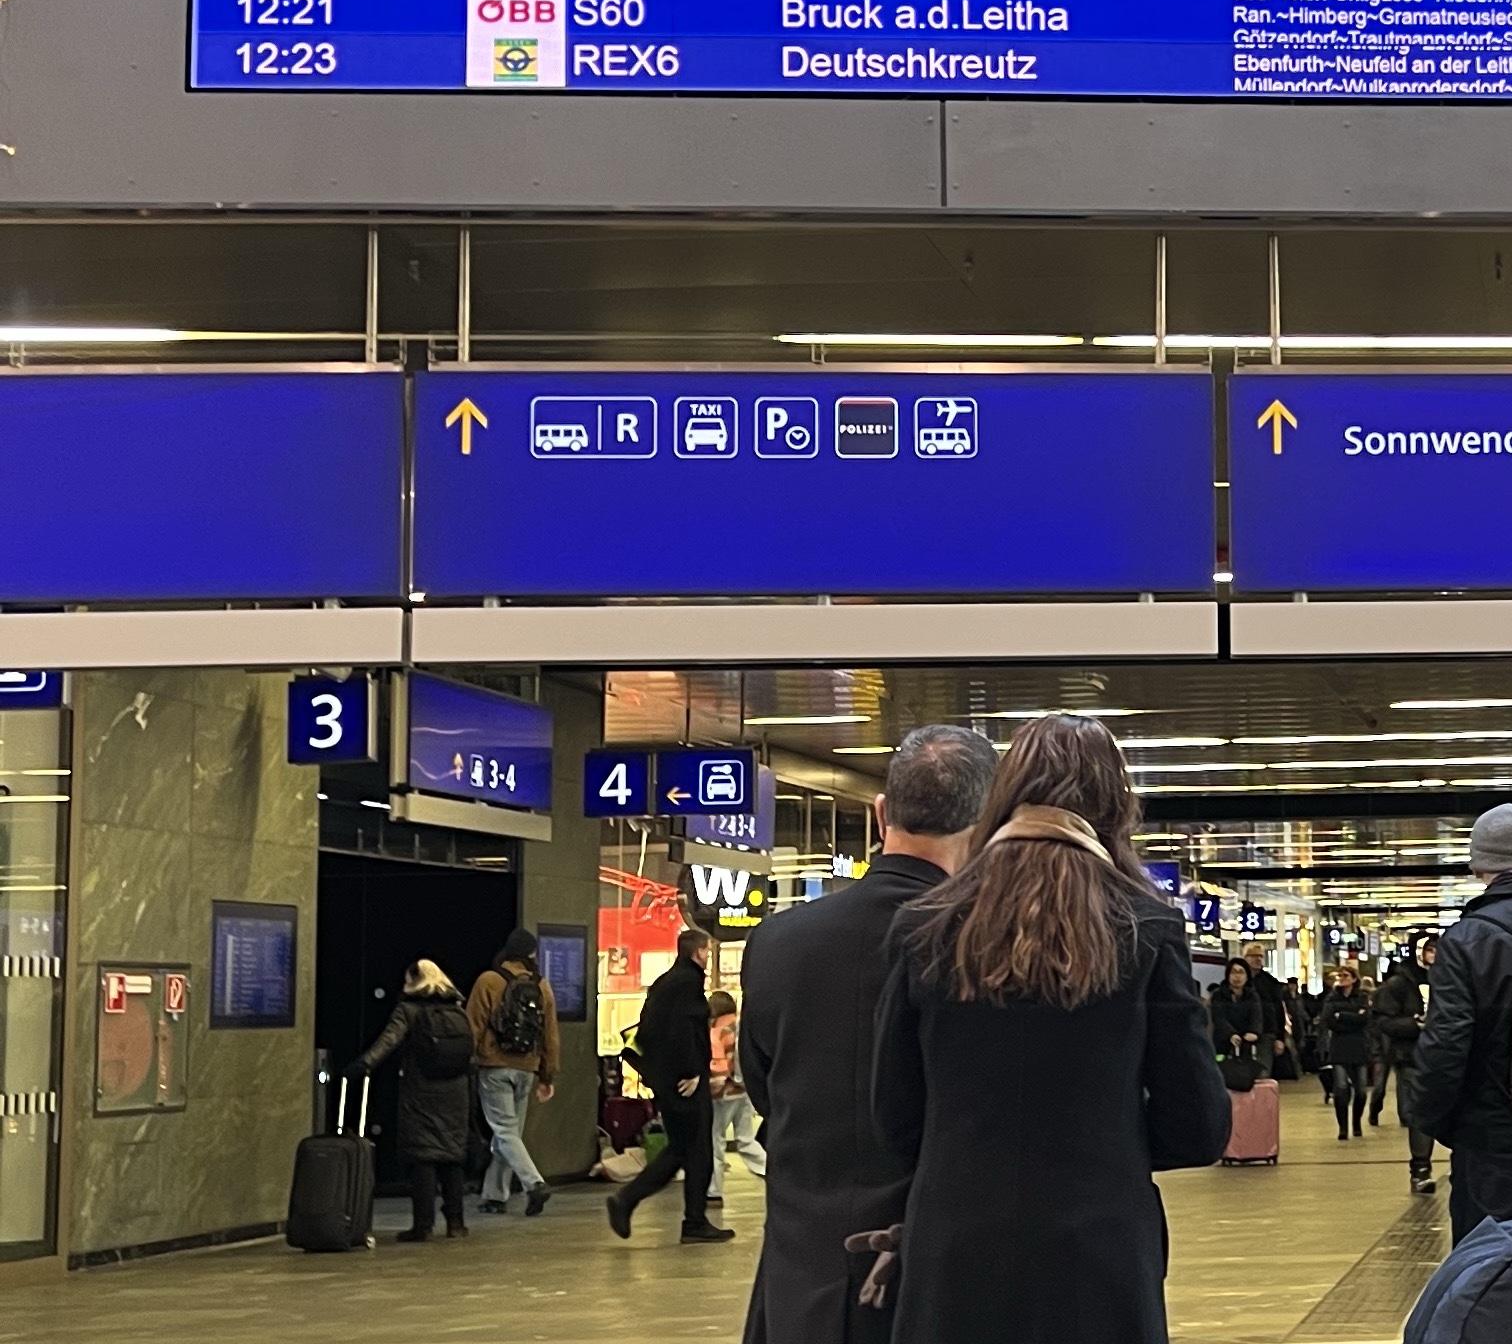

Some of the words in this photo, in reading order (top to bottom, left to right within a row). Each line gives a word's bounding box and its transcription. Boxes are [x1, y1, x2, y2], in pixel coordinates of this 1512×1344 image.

[895, 0, 1068, 30] a.d.Leitha
[237, 42, 336, 74] 12:23
[574, 45, 679, 76] REX6
[783, 46, 1037, 79] Deutschkreutz
[689, 404, 722, 416] TAXI
[309, 693, 344, 749] 3
[599, 763, 632, 805] 4
[1199, 900, 1213, 920] 7
[1246, 912, 1260, 929] 8
[1330, 929, 1341, 944] 9
